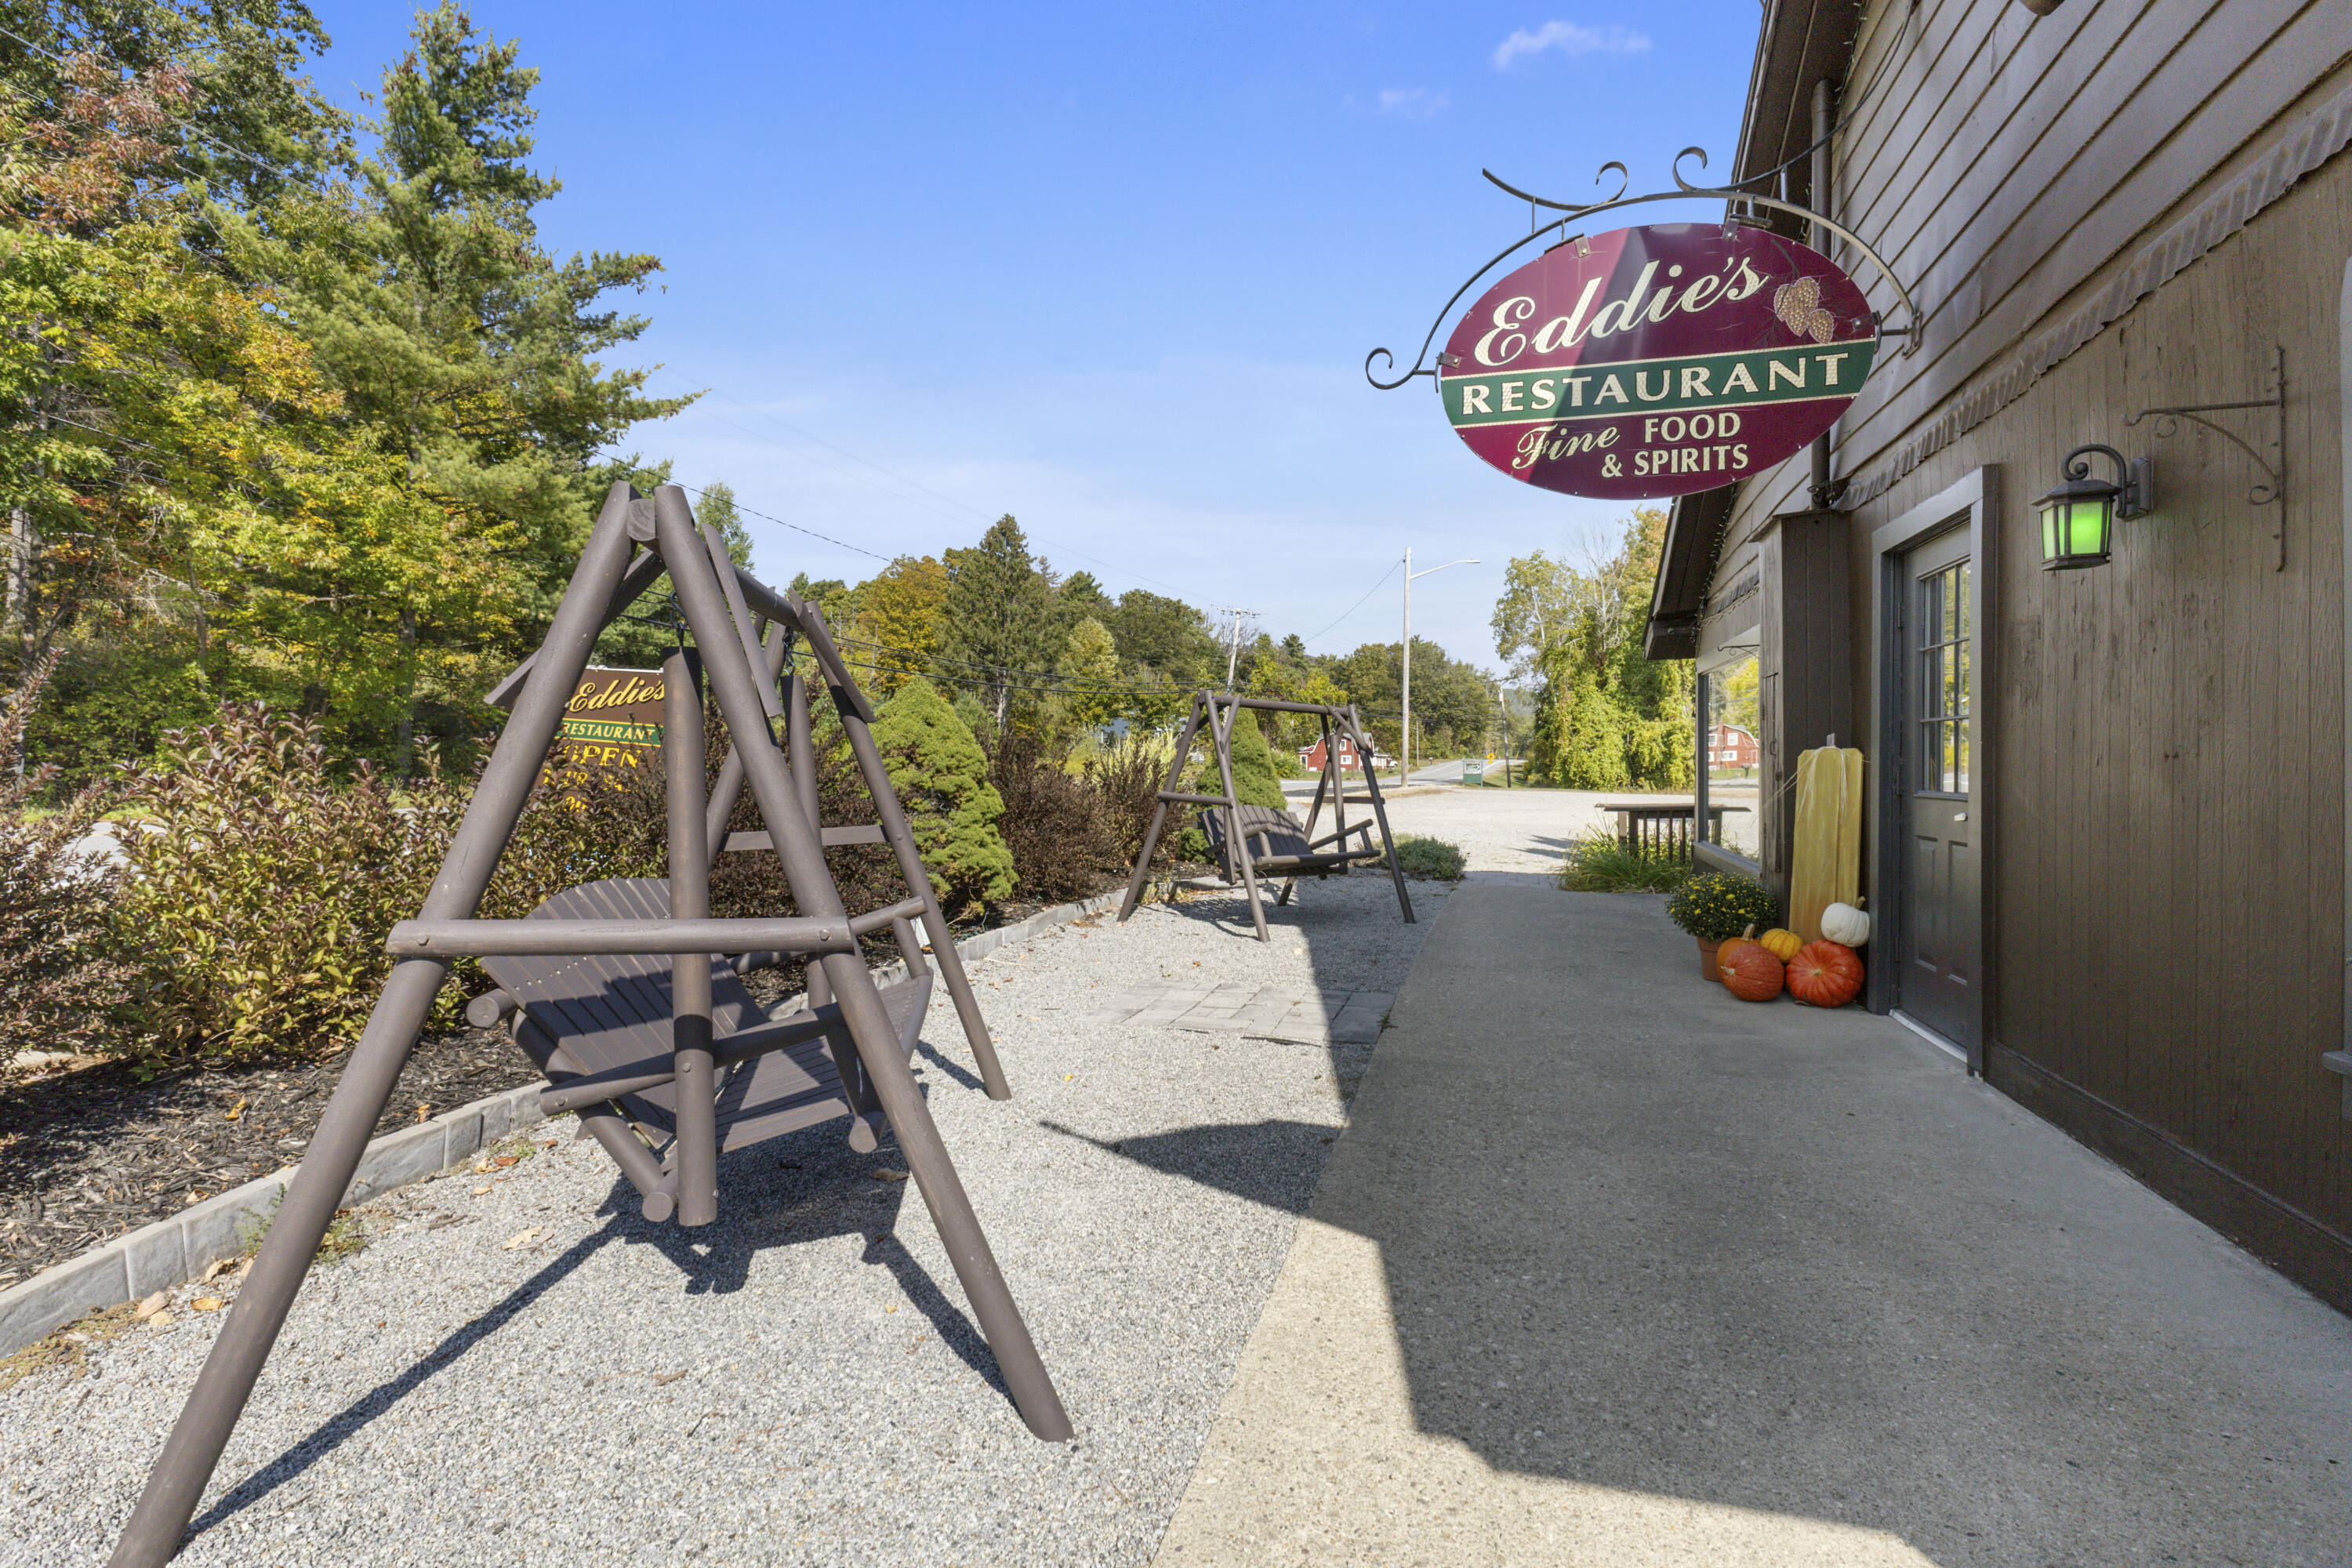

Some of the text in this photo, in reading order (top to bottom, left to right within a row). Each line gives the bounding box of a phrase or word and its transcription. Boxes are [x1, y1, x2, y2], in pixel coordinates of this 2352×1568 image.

[1475, 256, 1769, 366] Eddie's
[1461, 351, 1849, 416] RESTAURANT
[1512, 412, 1741, 470] Fine FOOD
[1600, 444, 1749, 478] & SPIRITS
[569, 677, 664, 712] Eddie's
